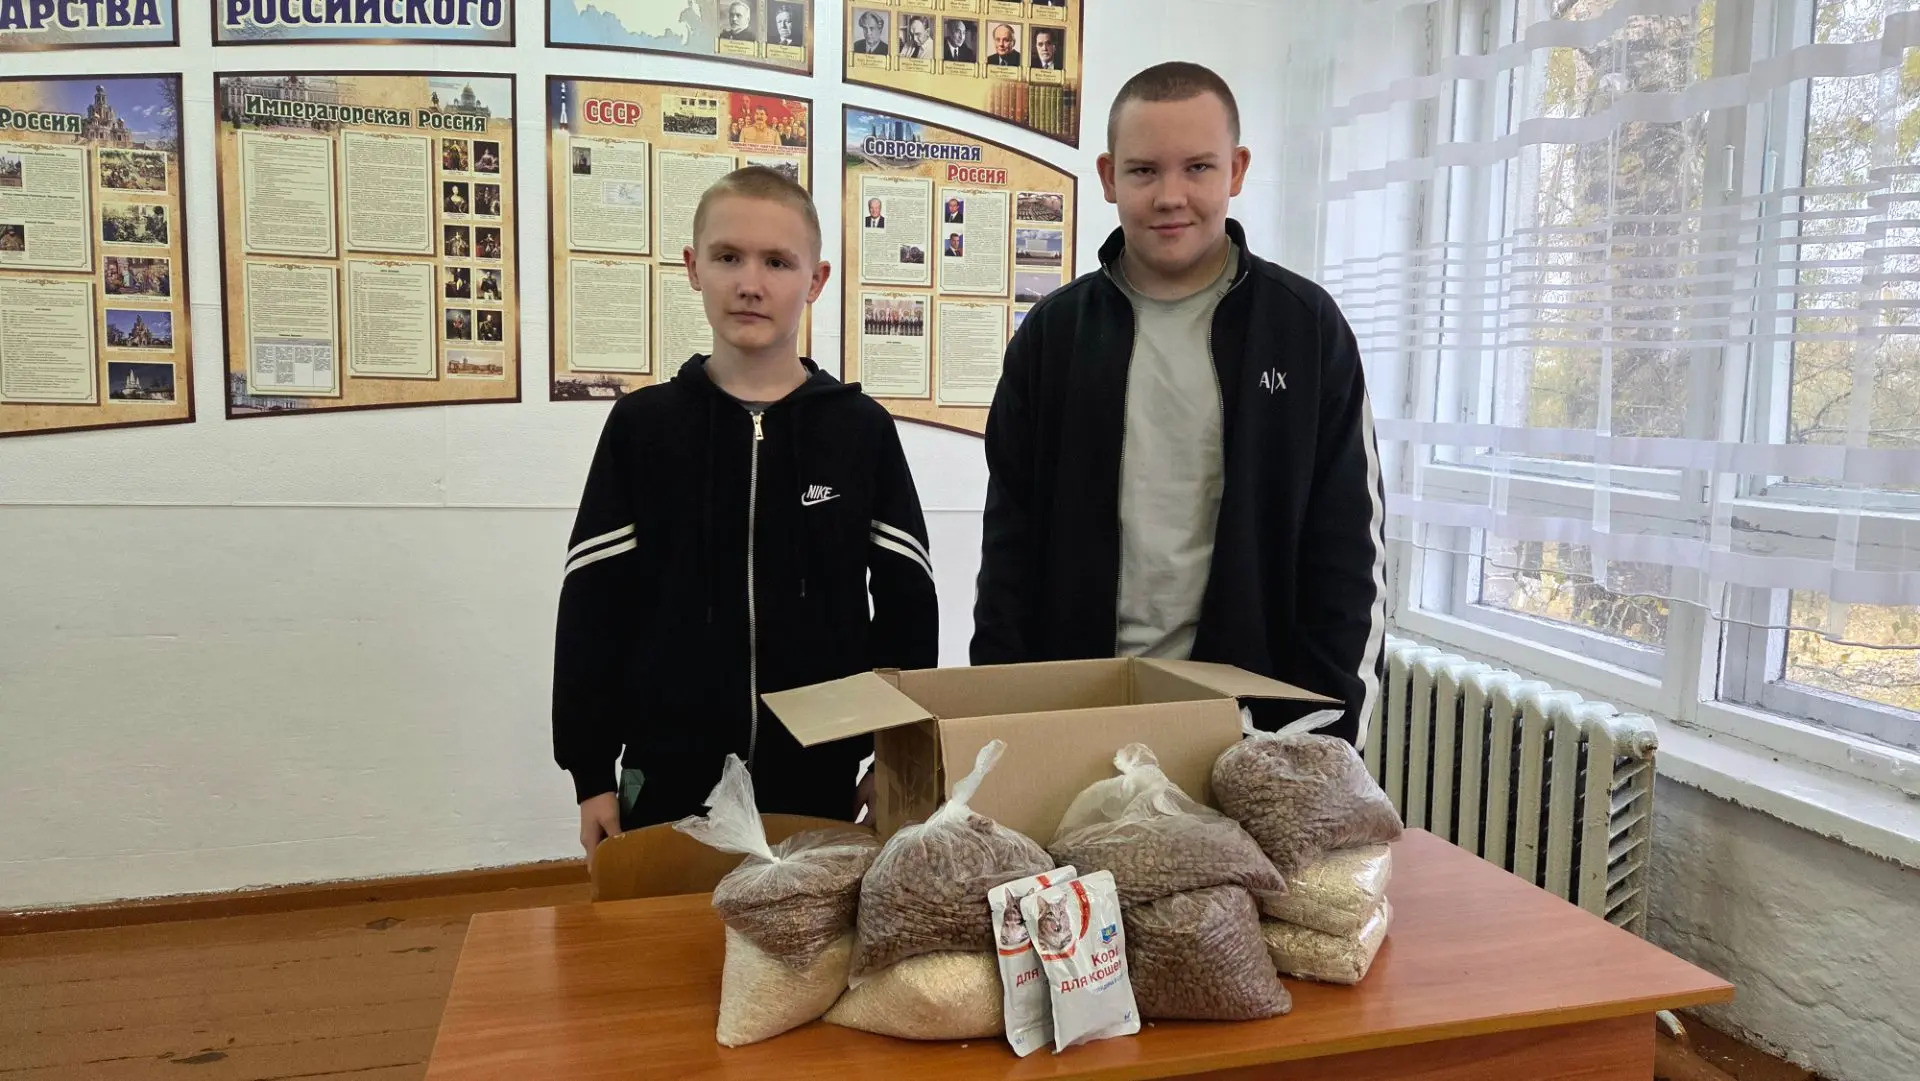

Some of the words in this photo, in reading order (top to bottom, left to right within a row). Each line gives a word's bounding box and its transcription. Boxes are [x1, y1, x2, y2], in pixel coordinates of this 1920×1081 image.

[246, 95, 411, 126] Императорская
[418, 110, 487, 132] Россия
[585, 100, 641, 125] СССР
[865, 136, 981, 161] Современная
[947, 164, 1007, 184] Россия
[806, 484, 833, 499] NIKE
[1016, 968, 1040, 988] для
[1061, 976, 1088, 994] для
